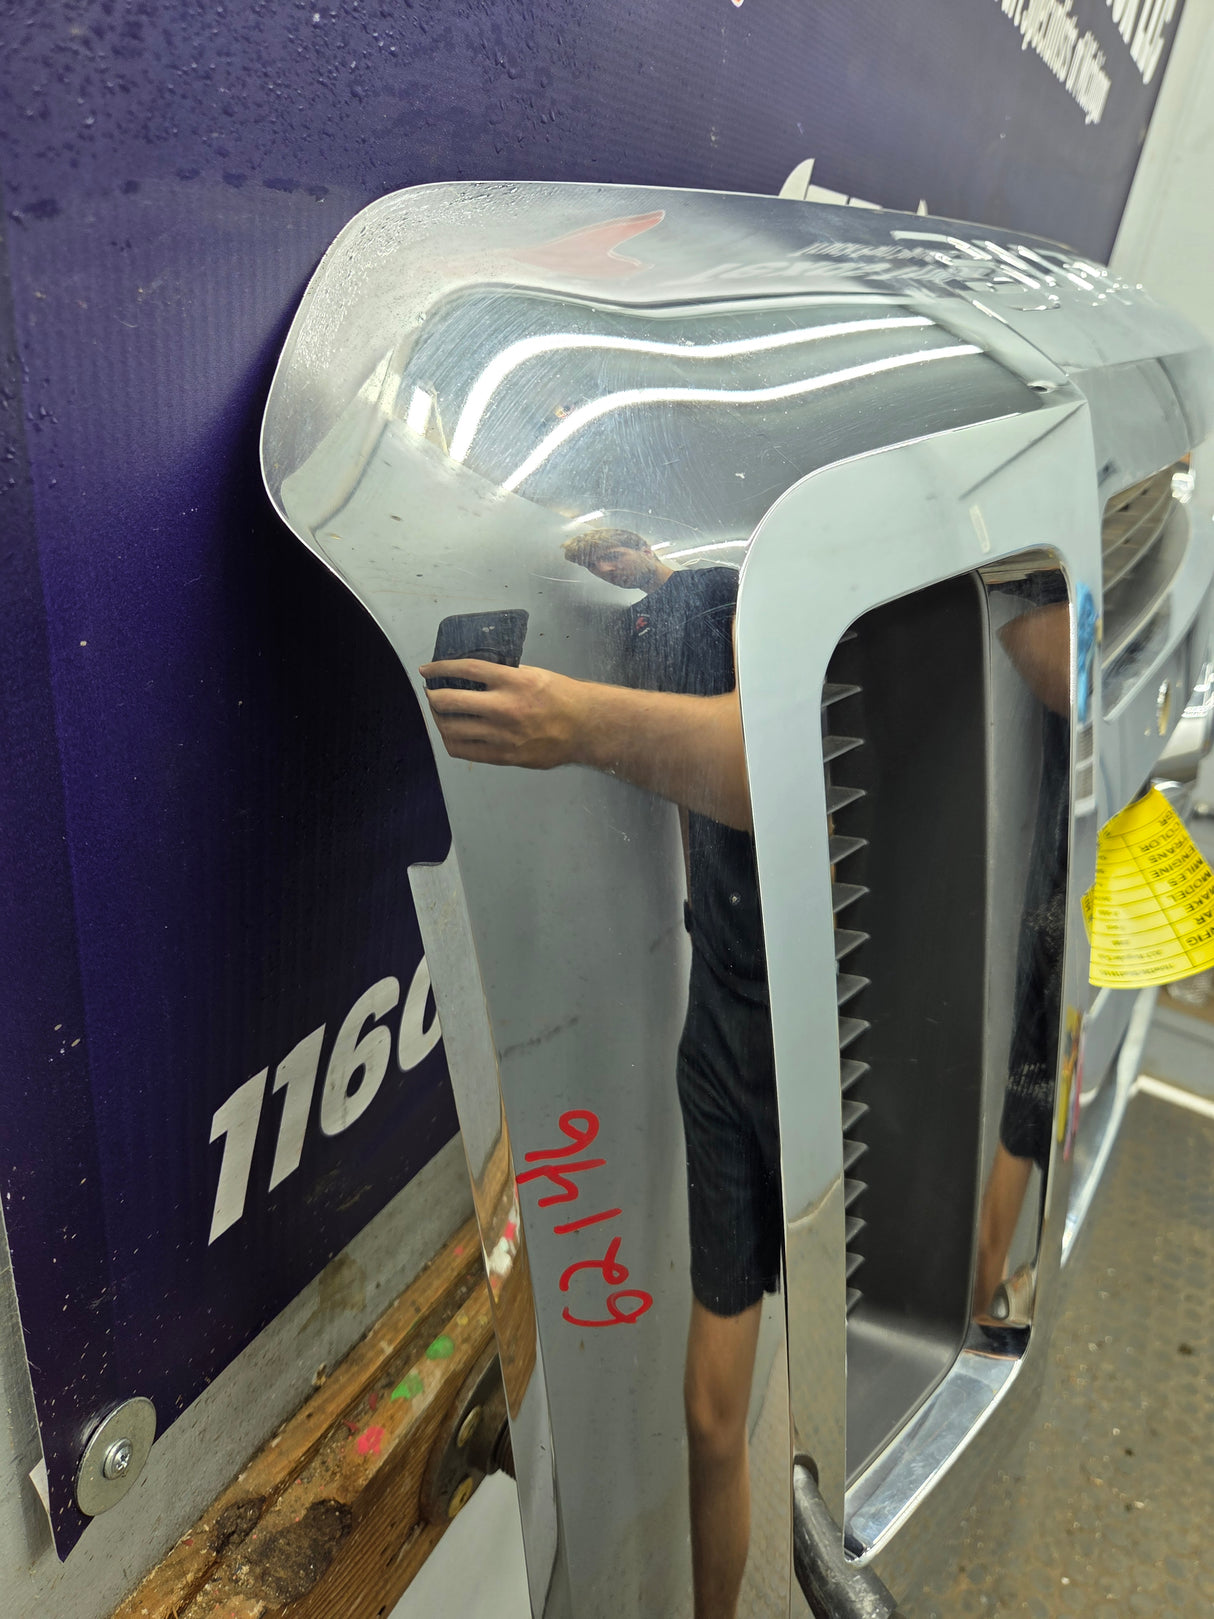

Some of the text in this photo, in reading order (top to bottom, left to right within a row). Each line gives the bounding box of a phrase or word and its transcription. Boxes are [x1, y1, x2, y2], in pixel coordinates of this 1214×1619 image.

[1140, 821, 1180, 852] COLOR
[1150, 846, 1196, 878] ENGINE
[1168, 857, 1204, 887] MILES
[1167, 870, 1212, 902] MODEL
